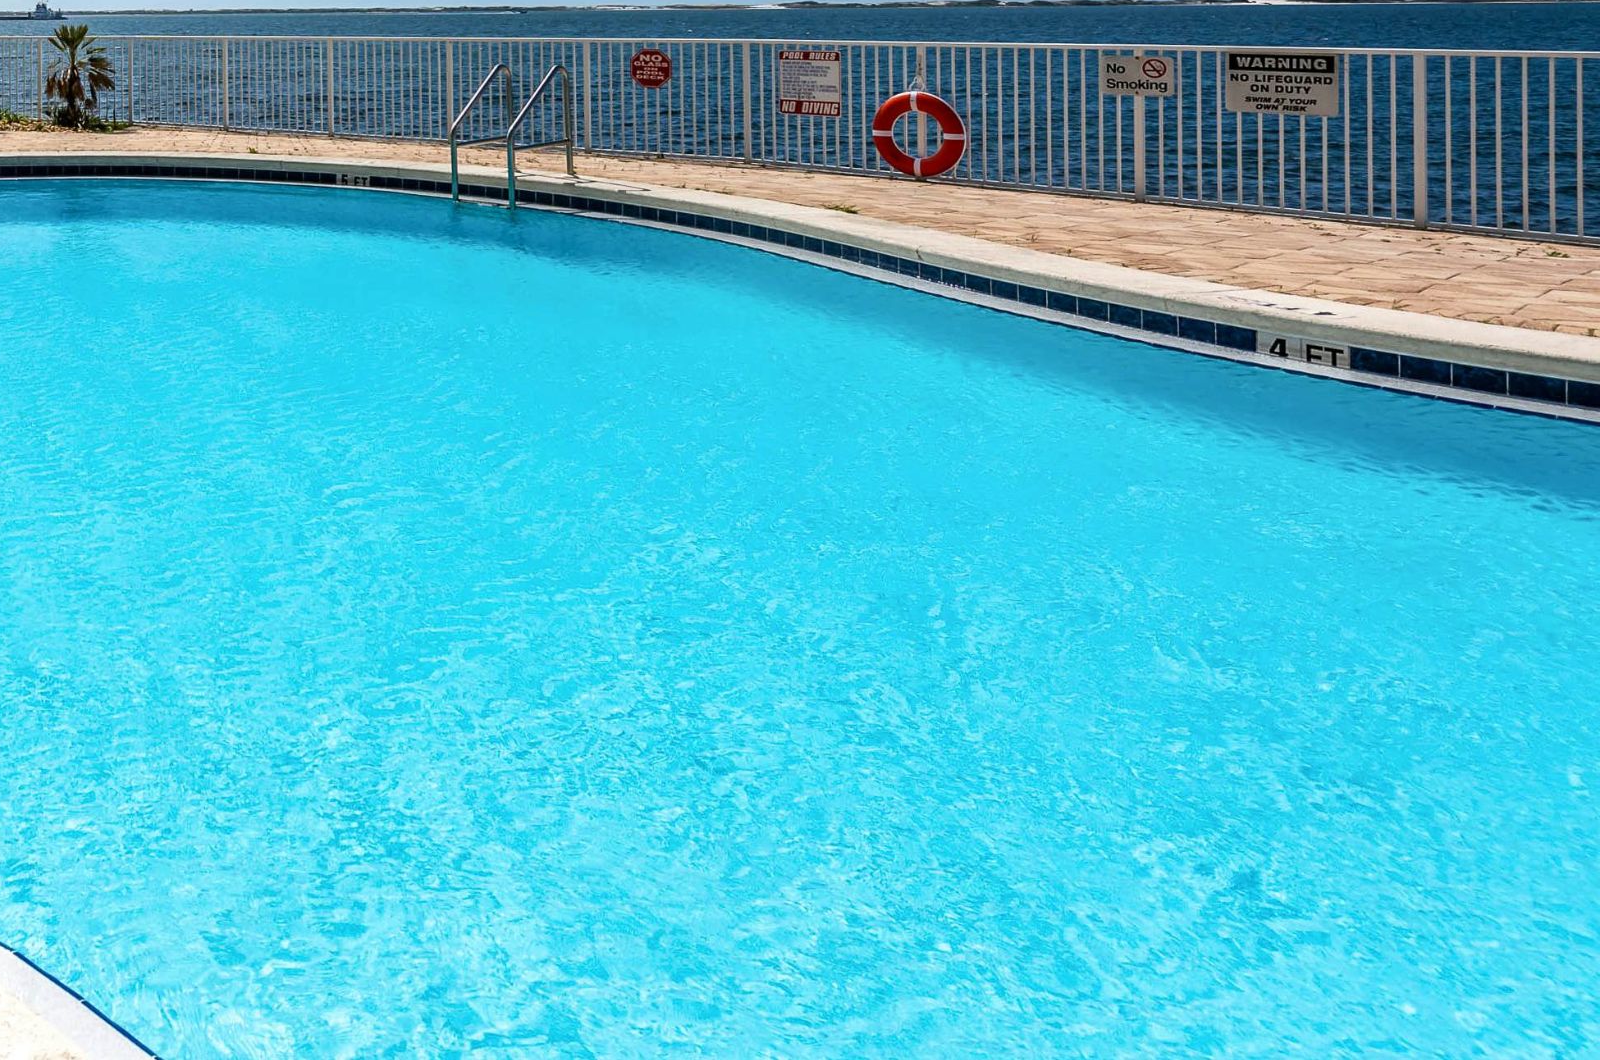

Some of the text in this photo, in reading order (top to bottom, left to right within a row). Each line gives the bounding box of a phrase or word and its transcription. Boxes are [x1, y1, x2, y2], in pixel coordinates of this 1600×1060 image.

[640, 54, 662, 62] NO
[783, 51, 836, 60] POOL RULES
[1106, 63, 1126, 74] No
[1236, 56, 1327, 70] WARNING
[1230, 73, 1333, 85] NO LIFEGUARD
[1106, 78, 1168, 93] Smoking
[1250, 84, 1311, 94] ON DUTY
[781, 101, 839, 115] NO DIVING
[354, 176, 368, 186] FT
[1269, 338, 1344, 366] 4 FT
